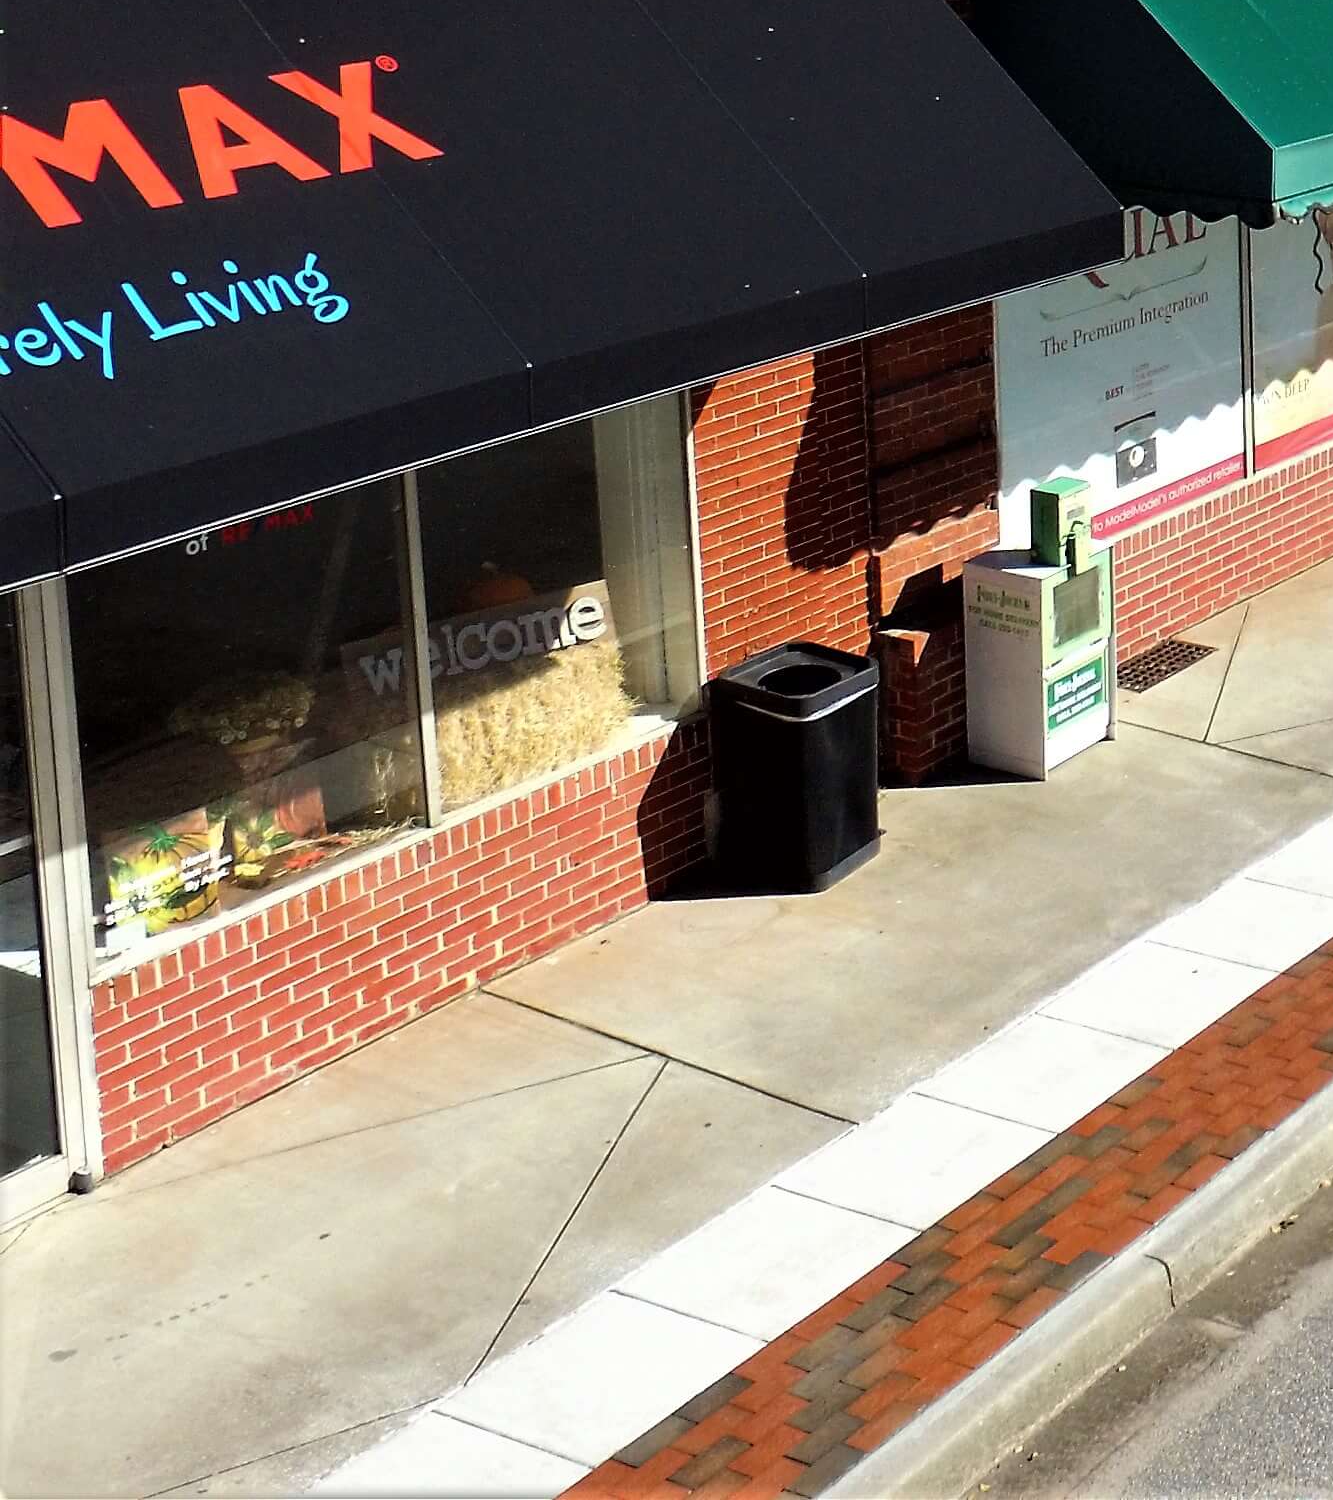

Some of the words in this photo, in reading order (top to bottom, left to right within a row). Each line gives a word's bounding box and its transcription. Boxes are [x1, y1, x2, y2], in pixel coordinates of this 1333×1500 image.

[121, 252, 349, 343] Living
[1040, 334, 1068, 357] The
[1072, 316, 1135, 349] Premium
[1139, 290, 1209, 325] Integration
[1104, 384, 1124, 401] BEST
[1168, 473, 1213, 500] authorized
[185, 533, 209, 555] of
